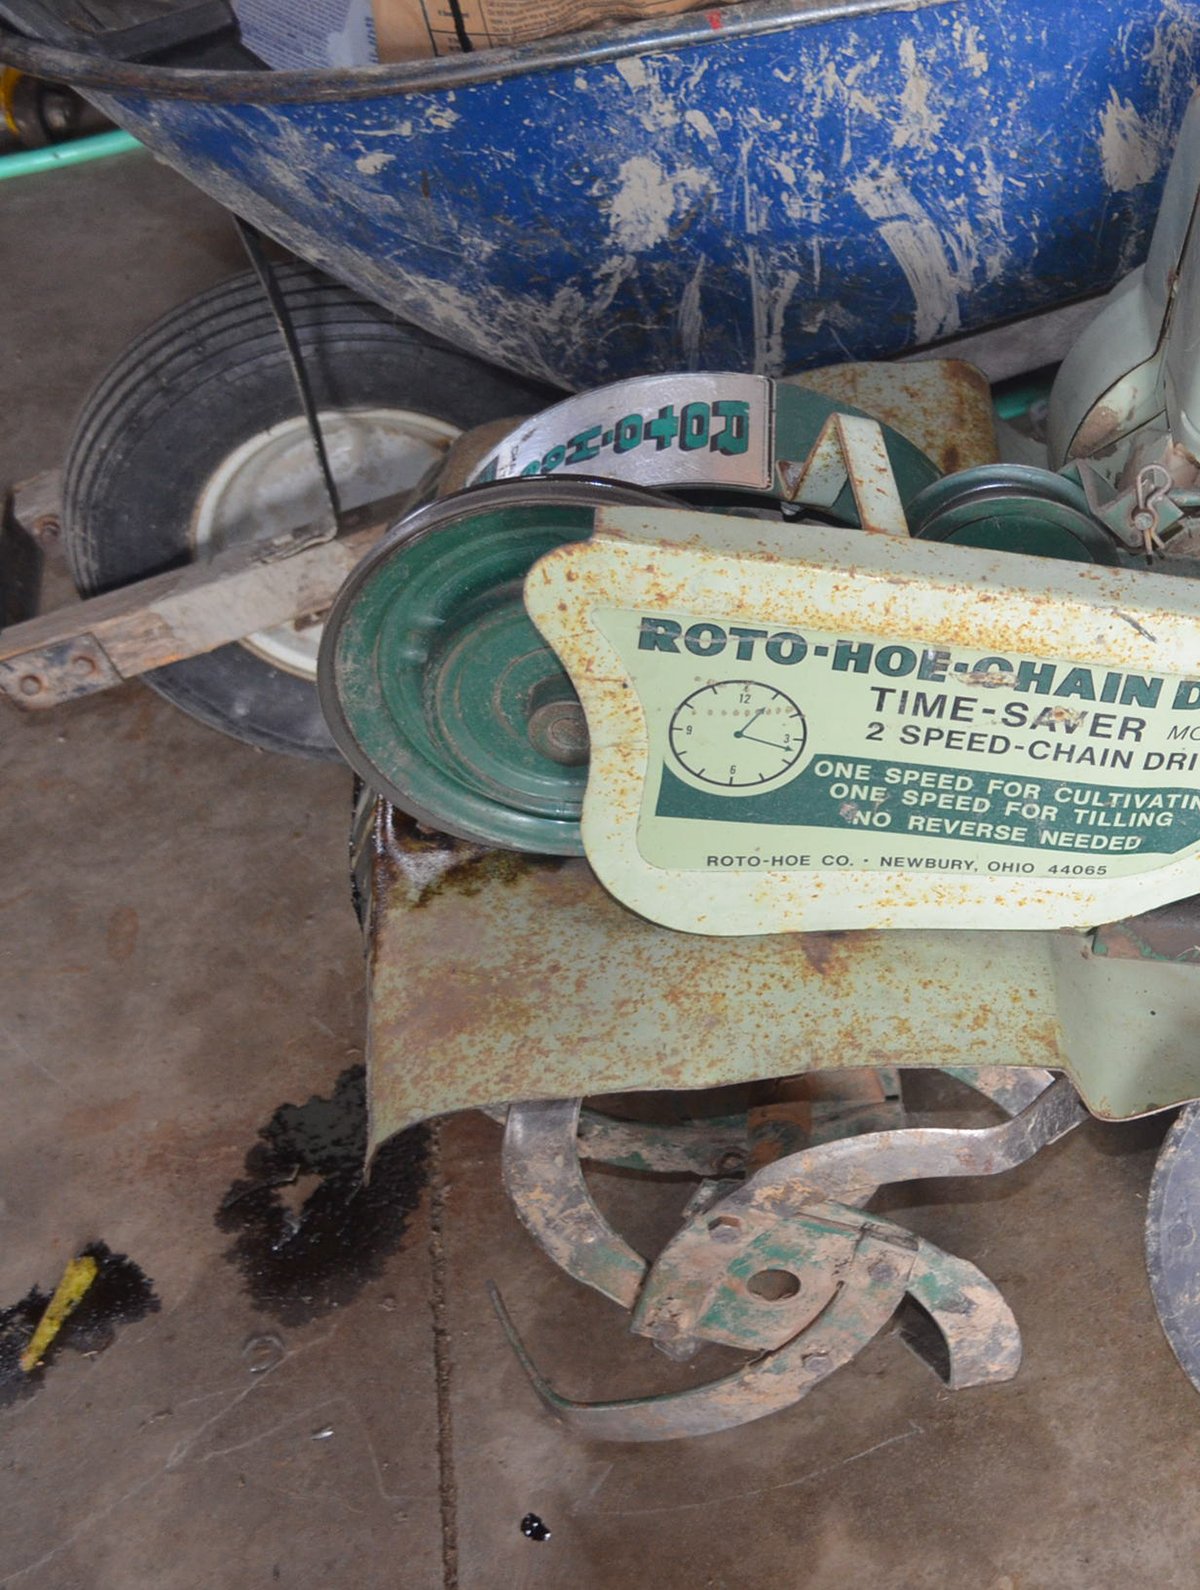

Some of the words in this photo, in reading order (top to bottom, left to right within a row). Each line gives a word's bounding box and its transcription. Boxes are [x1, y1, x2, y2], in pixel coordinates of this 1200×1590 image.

[637, 617, 1164, 708] ROTO-HOE-CHAIN
[739, 694, 751, 704] 12
[870, 686, 1147, 742] TIME-SAVER
[686, 726, 693, 735] 9
[783, 734, 790, 743] 3
[865, 722, 885, 741] 2
[899, 725, 1136, 770] SPEED-CHAIN
[730, 765, 736, 774] 6
[814, 760, 872, 780] ONE
[884, 768, 974, 792] SPEED
[987, 780, 1042, 799] FOR
[829, 783, 887, 803] ONE
[902, 790, 991, 813] SPEED
[1004, 802, 1059, 821] FOR
[1073, 808, 1174, 827] TILLING
[852, 810, 891, 828] NO
[908, 815, 1028, 842] REVERSE
[1040, 828, 1143, 851] NEEDED
[707, 855, 811, 867] ROTO-HOE
[822, 855, 854, 867] CO.
[880, 856, 978, 872] NEWBURY,
[987, 861, 1035, 874] OHIO
[1048, 864, 1107, 875] 44065
